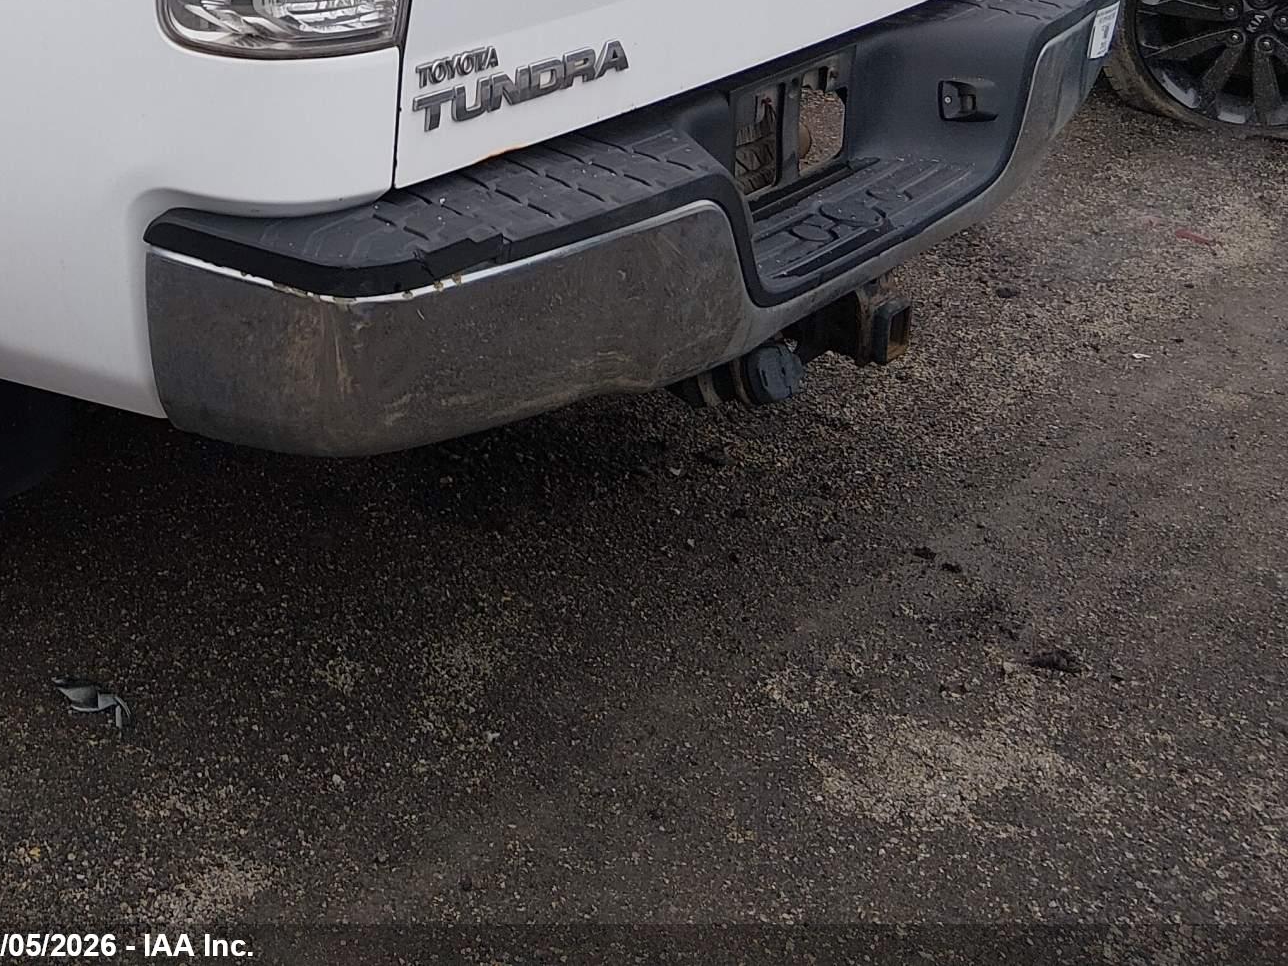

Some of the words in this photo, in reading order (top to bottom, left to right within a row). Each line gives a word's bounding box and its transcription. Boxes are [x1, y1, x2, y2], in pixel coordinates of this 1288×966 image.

[1246, 14, 1265, 33] KIA
[413, 40, 629, 133] TUNDRA
[415, 45, 499, 89] TOYOTA
